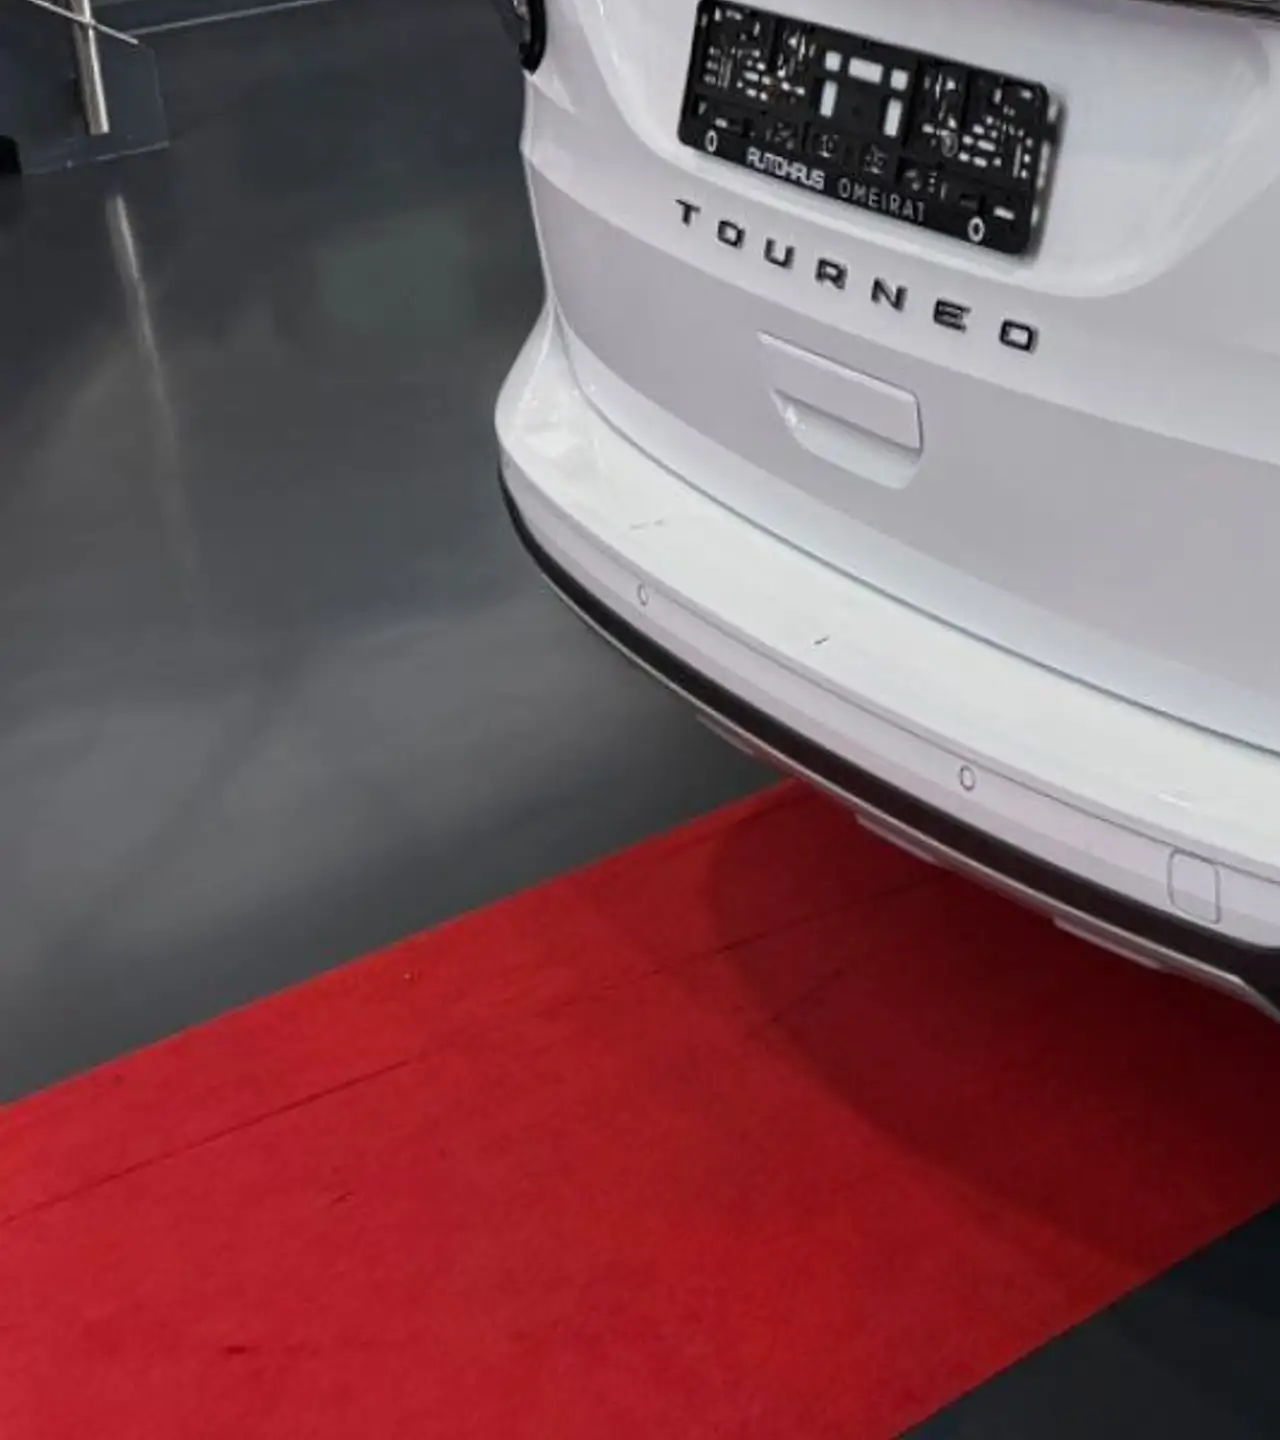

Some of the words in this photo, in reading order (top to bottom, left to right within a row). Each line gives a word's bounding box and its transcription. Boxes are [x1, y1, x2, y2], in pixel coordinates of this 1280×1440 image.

[747, 146, 825, 190] AUTOHAUS
[837, 177, 925, 222] OMEIRAT
[676, 199, 1036, 352] TOURNEO
